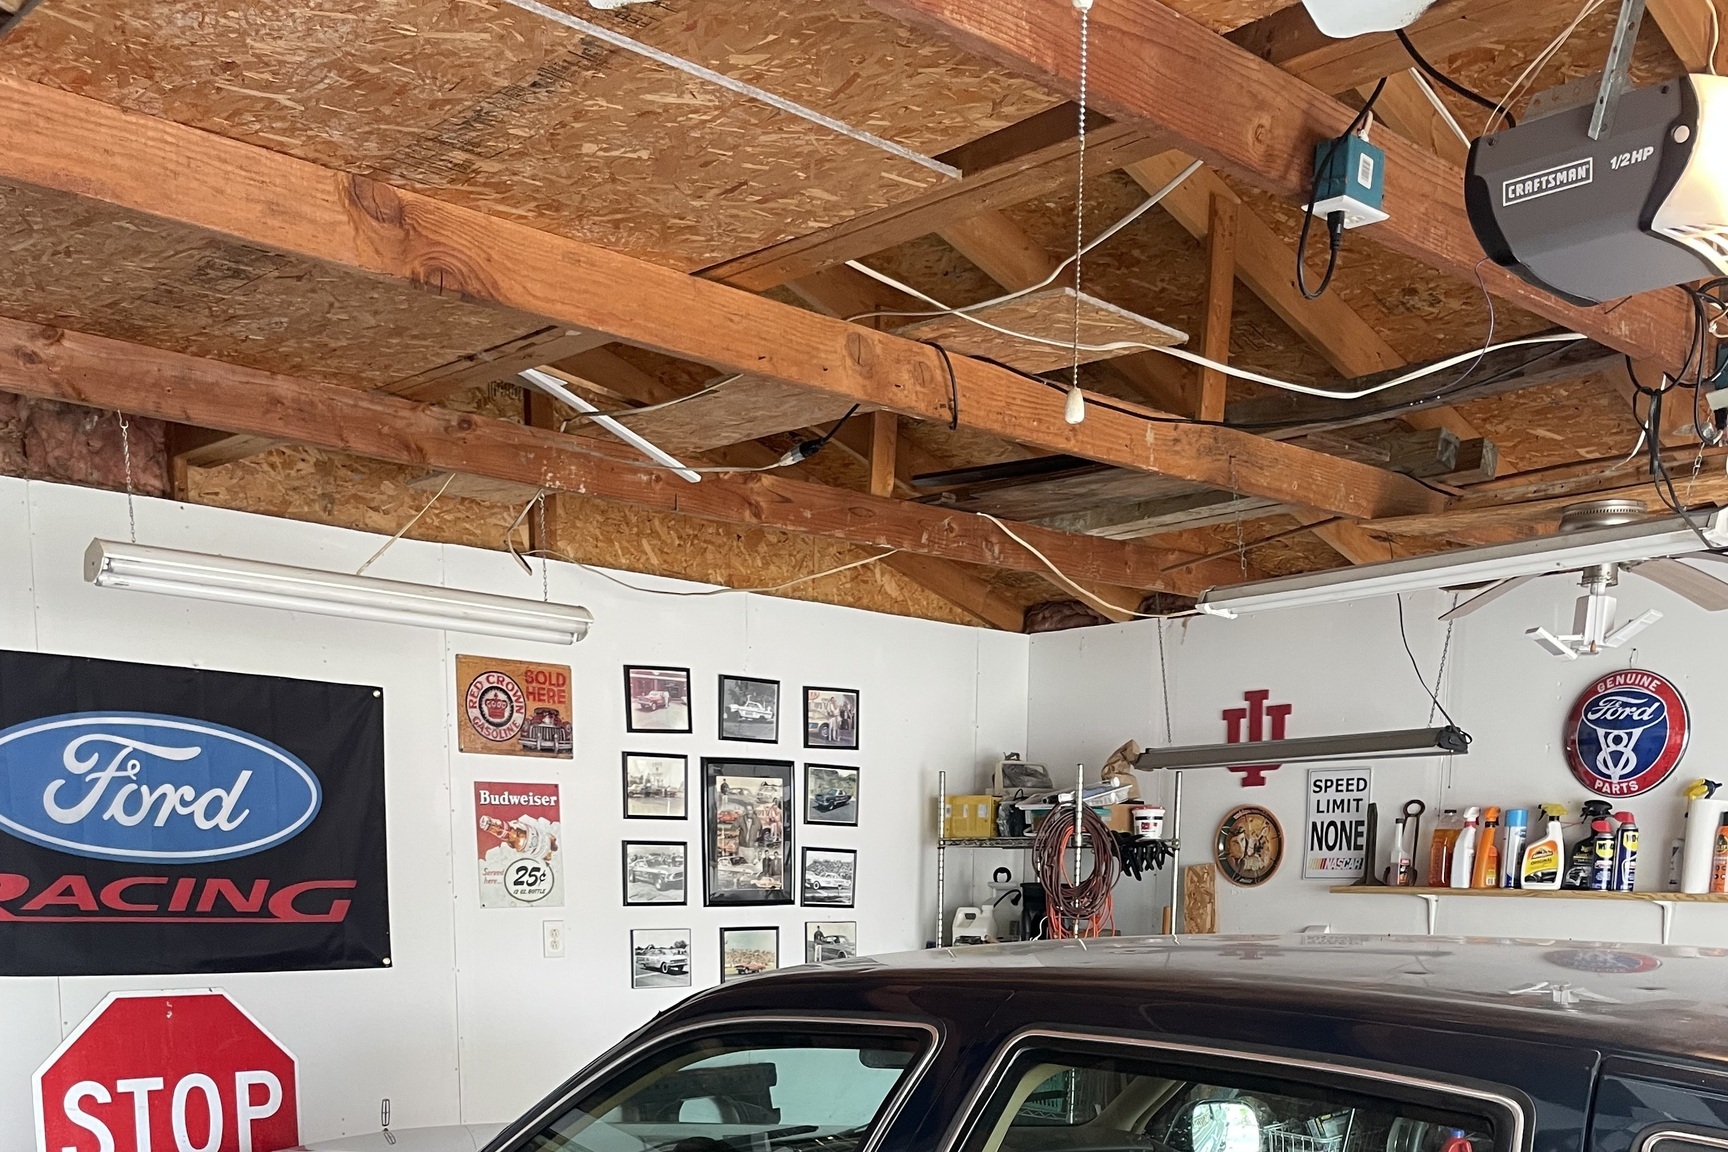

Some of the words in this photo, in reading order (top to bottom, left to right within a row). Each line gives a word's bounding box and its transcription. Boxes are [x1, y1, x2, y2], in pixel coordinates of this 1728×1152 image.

[1508, 165, 1588, 198] CRAFTSMAN
[524, 669, 567, 688] SOLD
[1597, 673, 1661, 693] GENUINE
[468, 681, 484, 709] RED
[485, 674, 524, 714] CROWN
[525, 686, 567, 705] HERE
[1587, 696, 1660, 720] Ford
[472, 716, 521, 739] GASOLINE
[43, 733, 253, 832] Ford
[1312, 777, 1368, 794] SPEED
[1594, 780, 1639, 794] PARTS
[479, 789, 558, 806] Budweiser
[1316, 798, 1364, 814] LIMIT
[1310, 820, 1365, 851] NONE
[482, 867, 505, 876] Served
[1324, 857, 1362, 870] NASCAR
